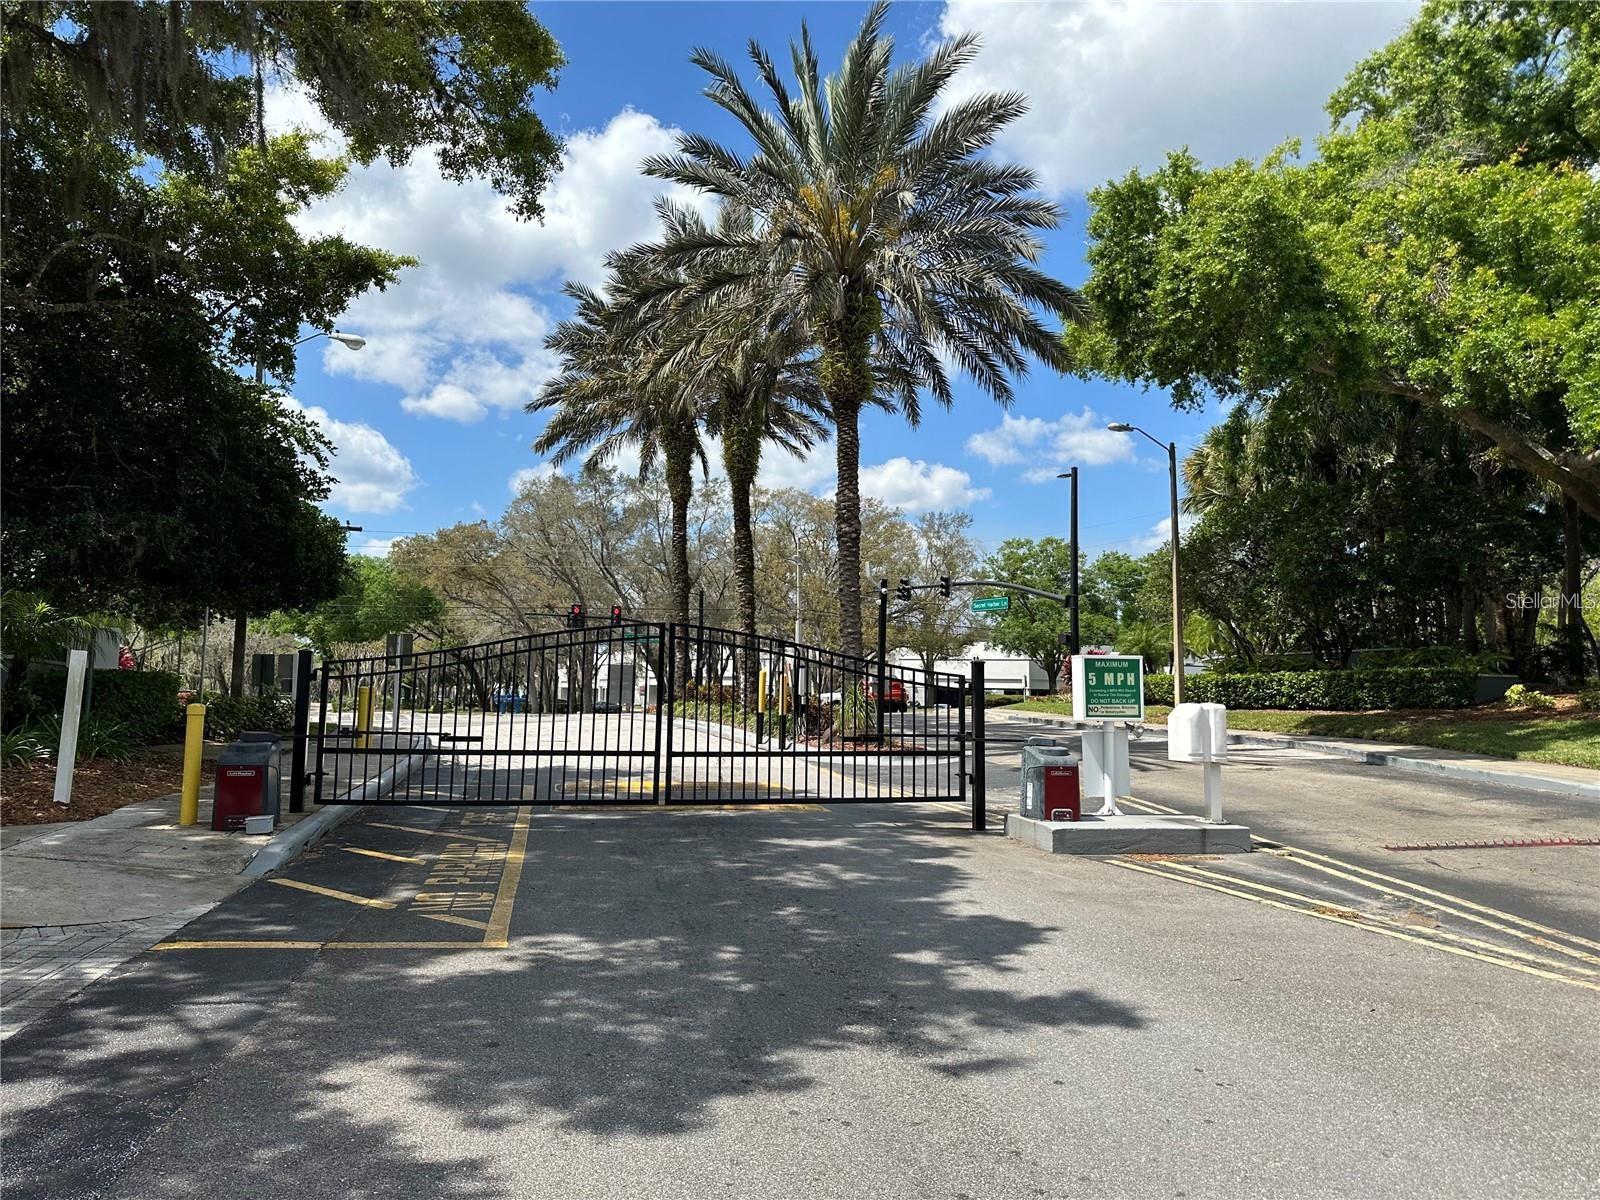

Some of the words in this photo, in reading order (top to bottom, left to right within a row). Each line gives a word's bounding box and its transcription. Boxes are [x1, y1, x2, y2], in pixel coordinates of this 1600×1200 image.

[1088, 672, 1097, 686] 5
[1104, 672, 1135, 686] MPH
[408, 892, 496, 911] NO
